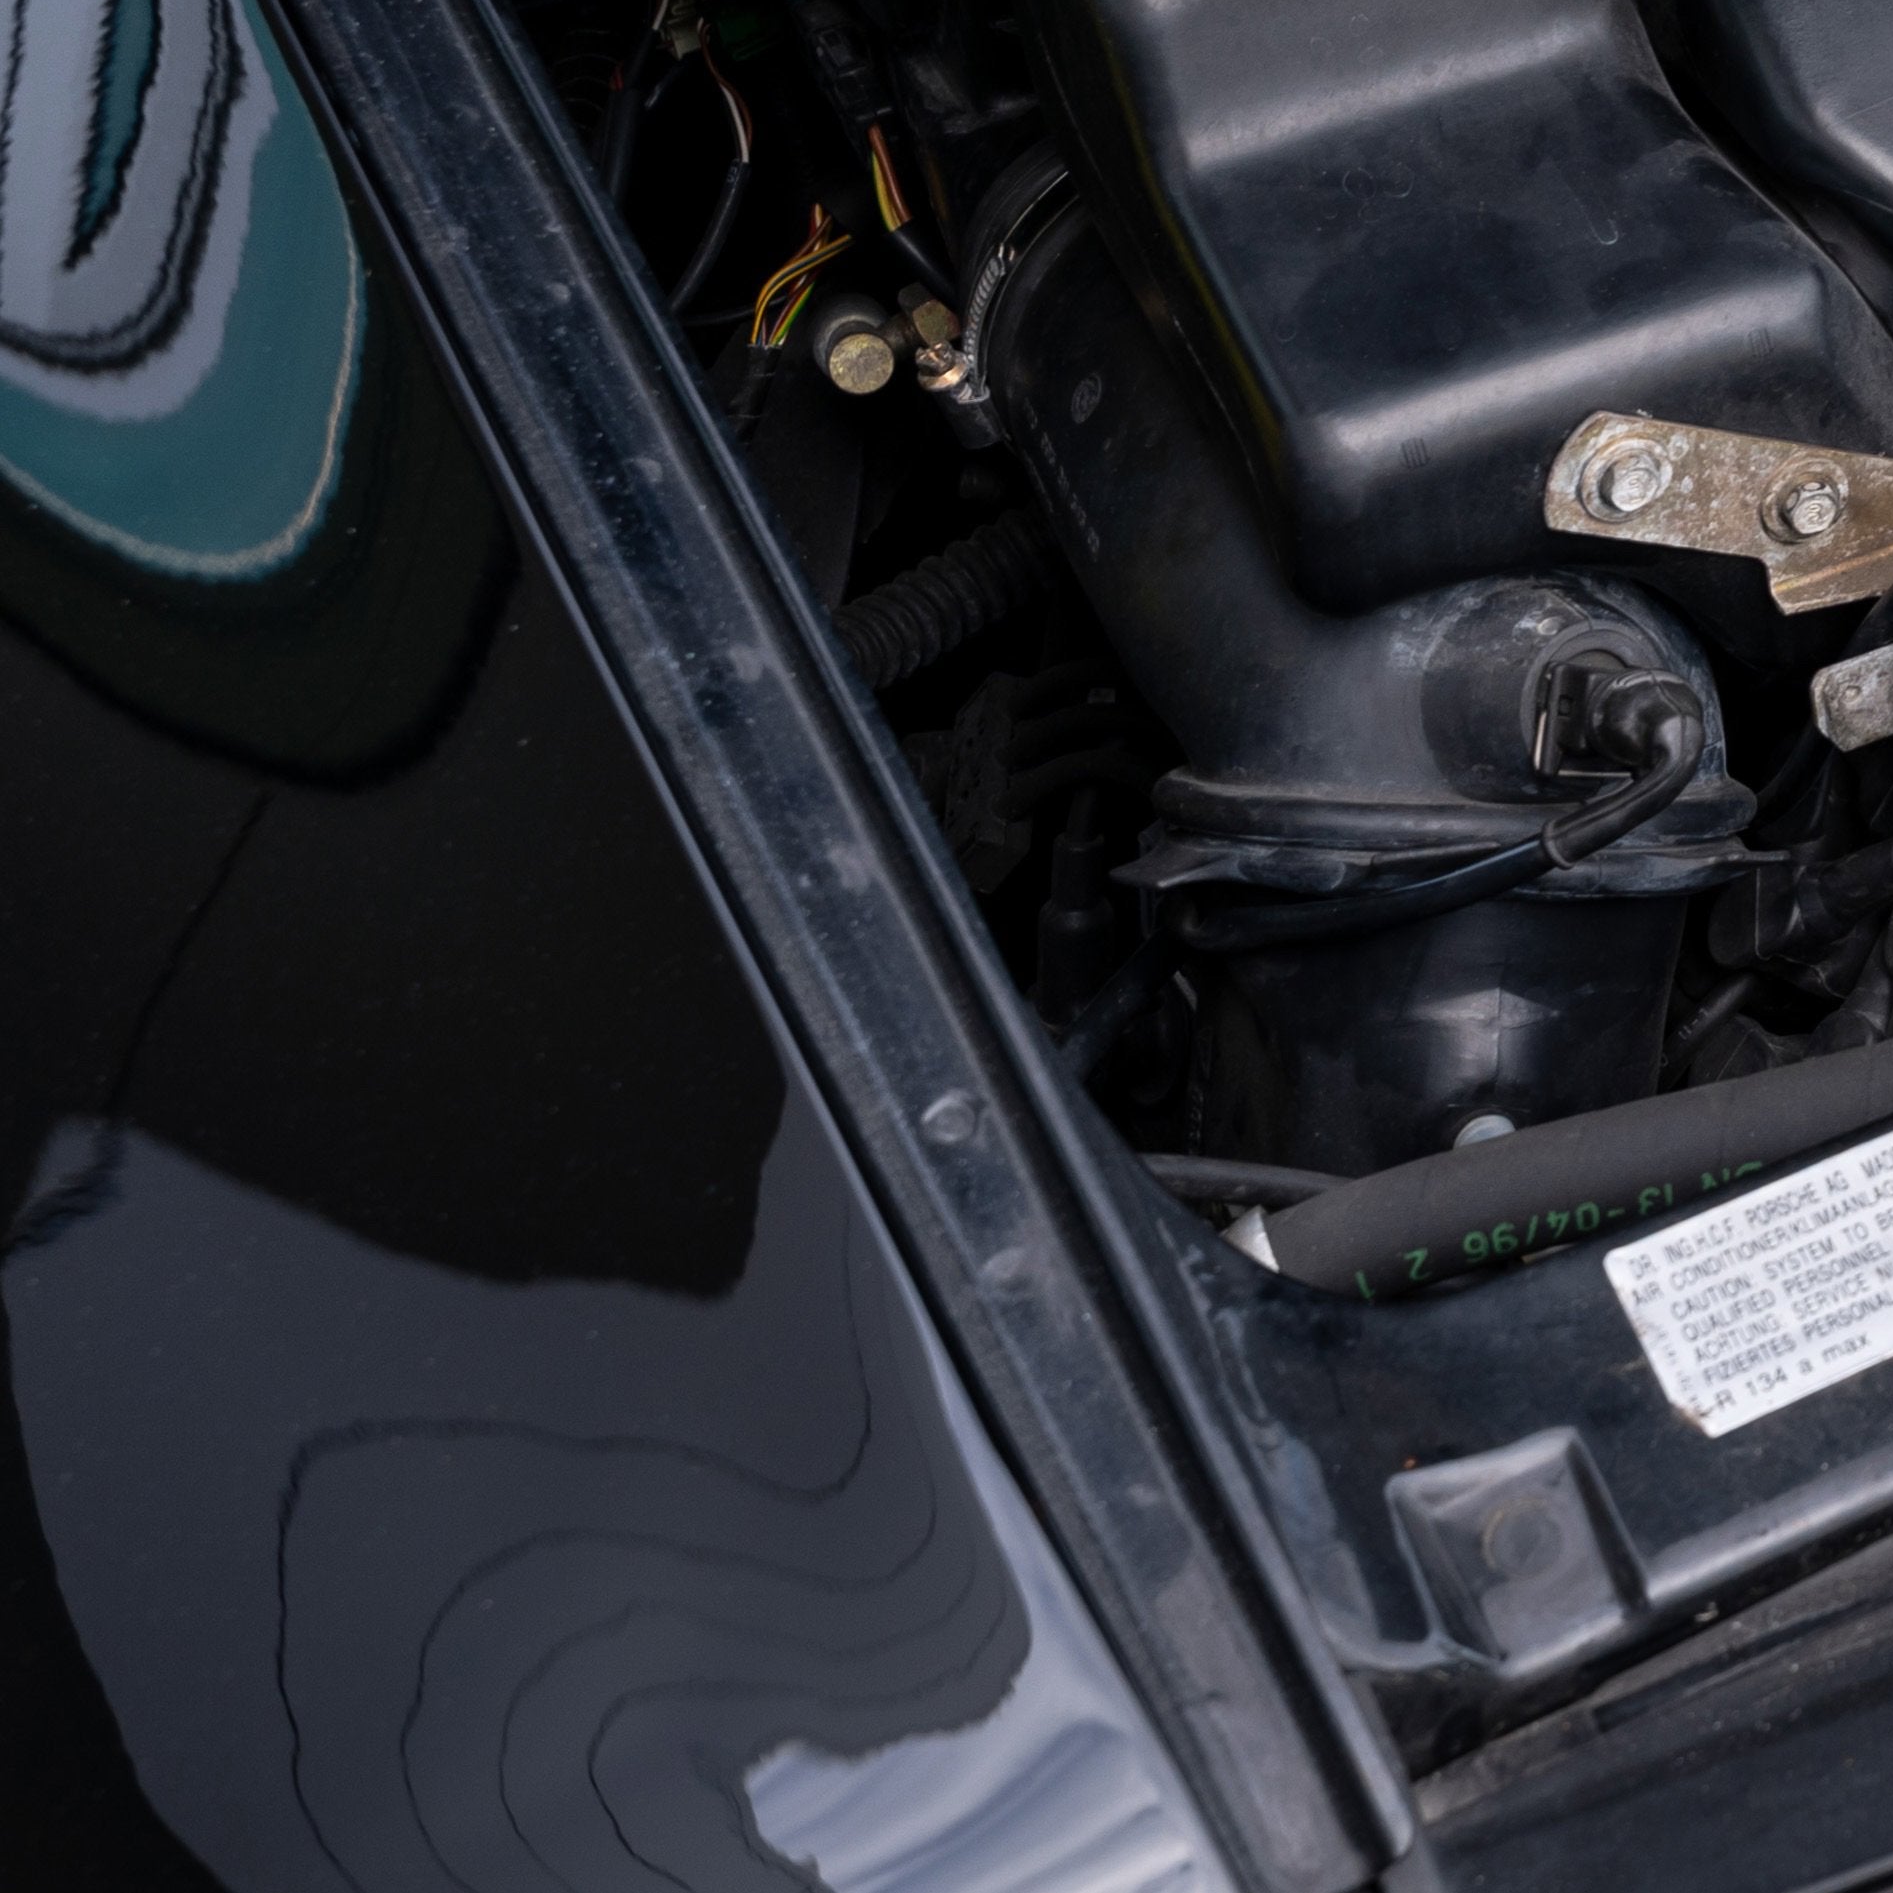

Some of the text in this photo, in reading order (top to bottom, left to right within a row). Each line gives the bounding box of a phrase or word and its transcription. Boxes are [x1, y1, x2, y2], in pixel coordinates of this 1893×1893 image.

[1678, 1287, 1779, 1345] QUALIFIED
[1779, 1237, 1890, 1300] PERSONNEL
[1759, 1234, 1839, 1282] SYSTEM
[1842, 1221, 1870, 1245] TO
